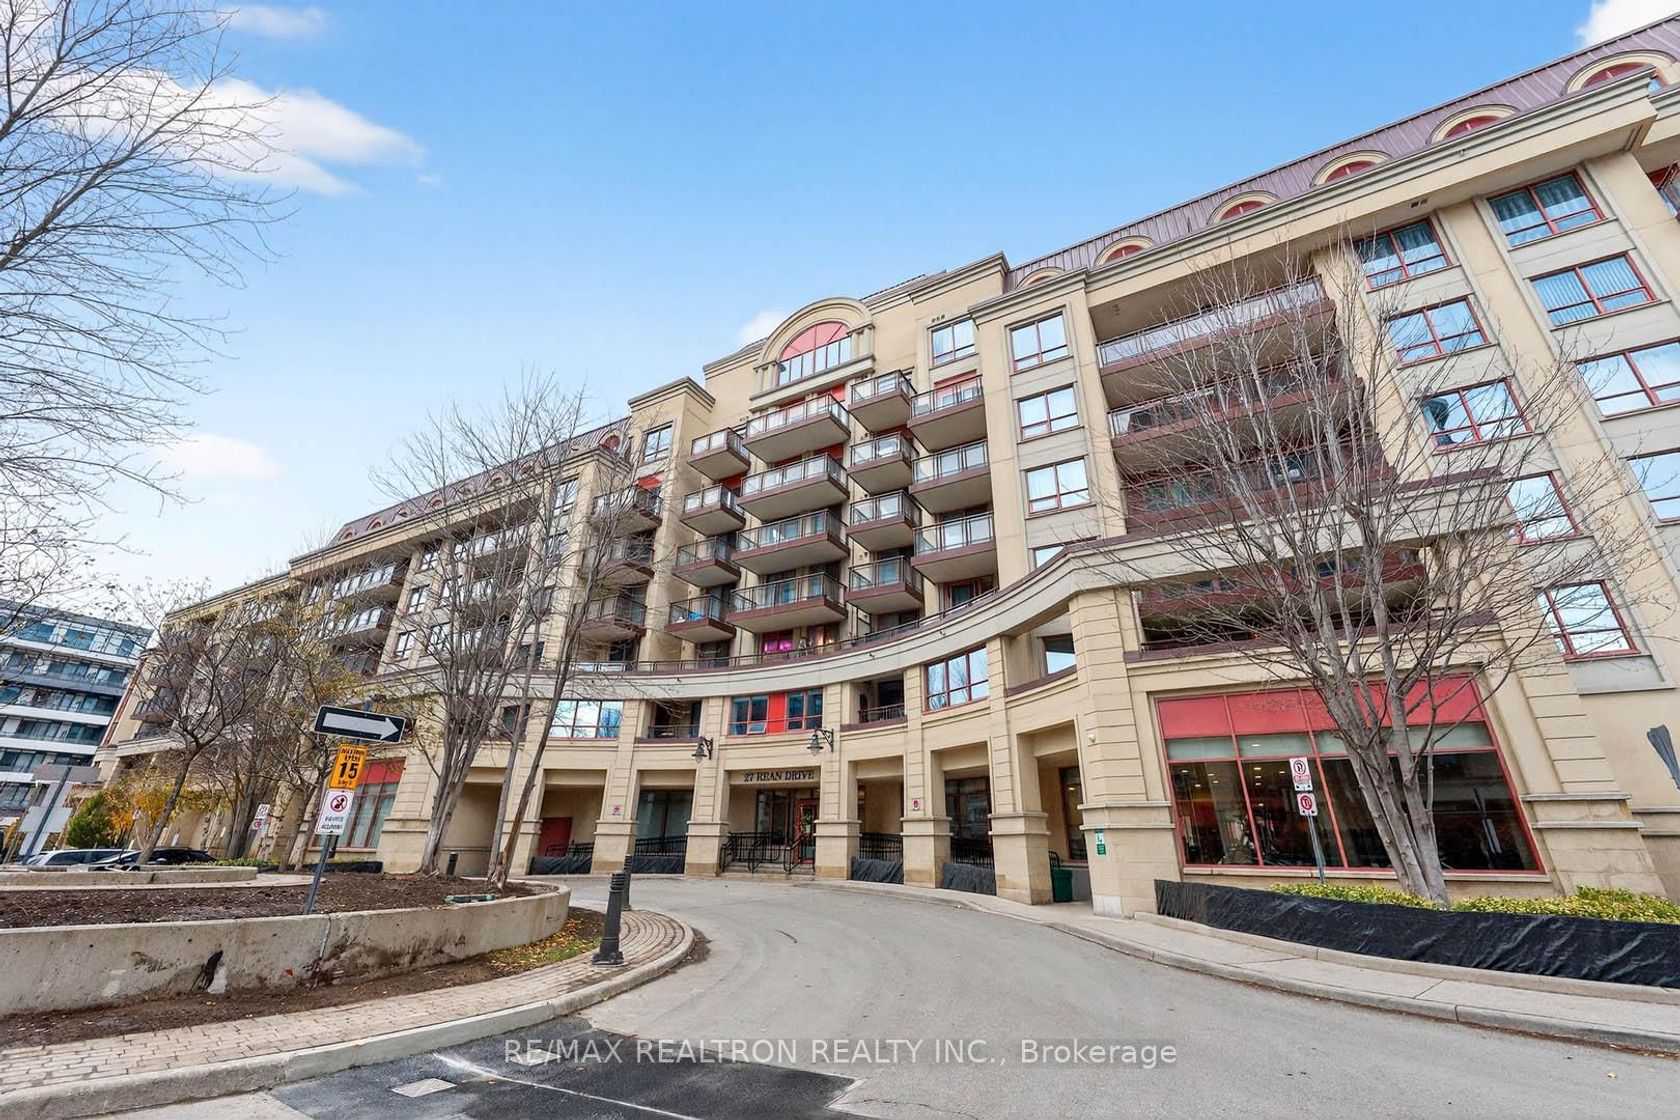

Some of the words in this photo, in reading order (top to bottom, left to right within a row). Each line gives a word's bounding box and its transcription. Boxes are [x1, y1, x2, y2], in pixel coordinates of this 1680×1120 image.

[339, 762, 359, 779] 15
[744, 772, 754, 782] 27
[756, 771, 782, 781] REAN
[785, 770, 814, 780] DRIVE
